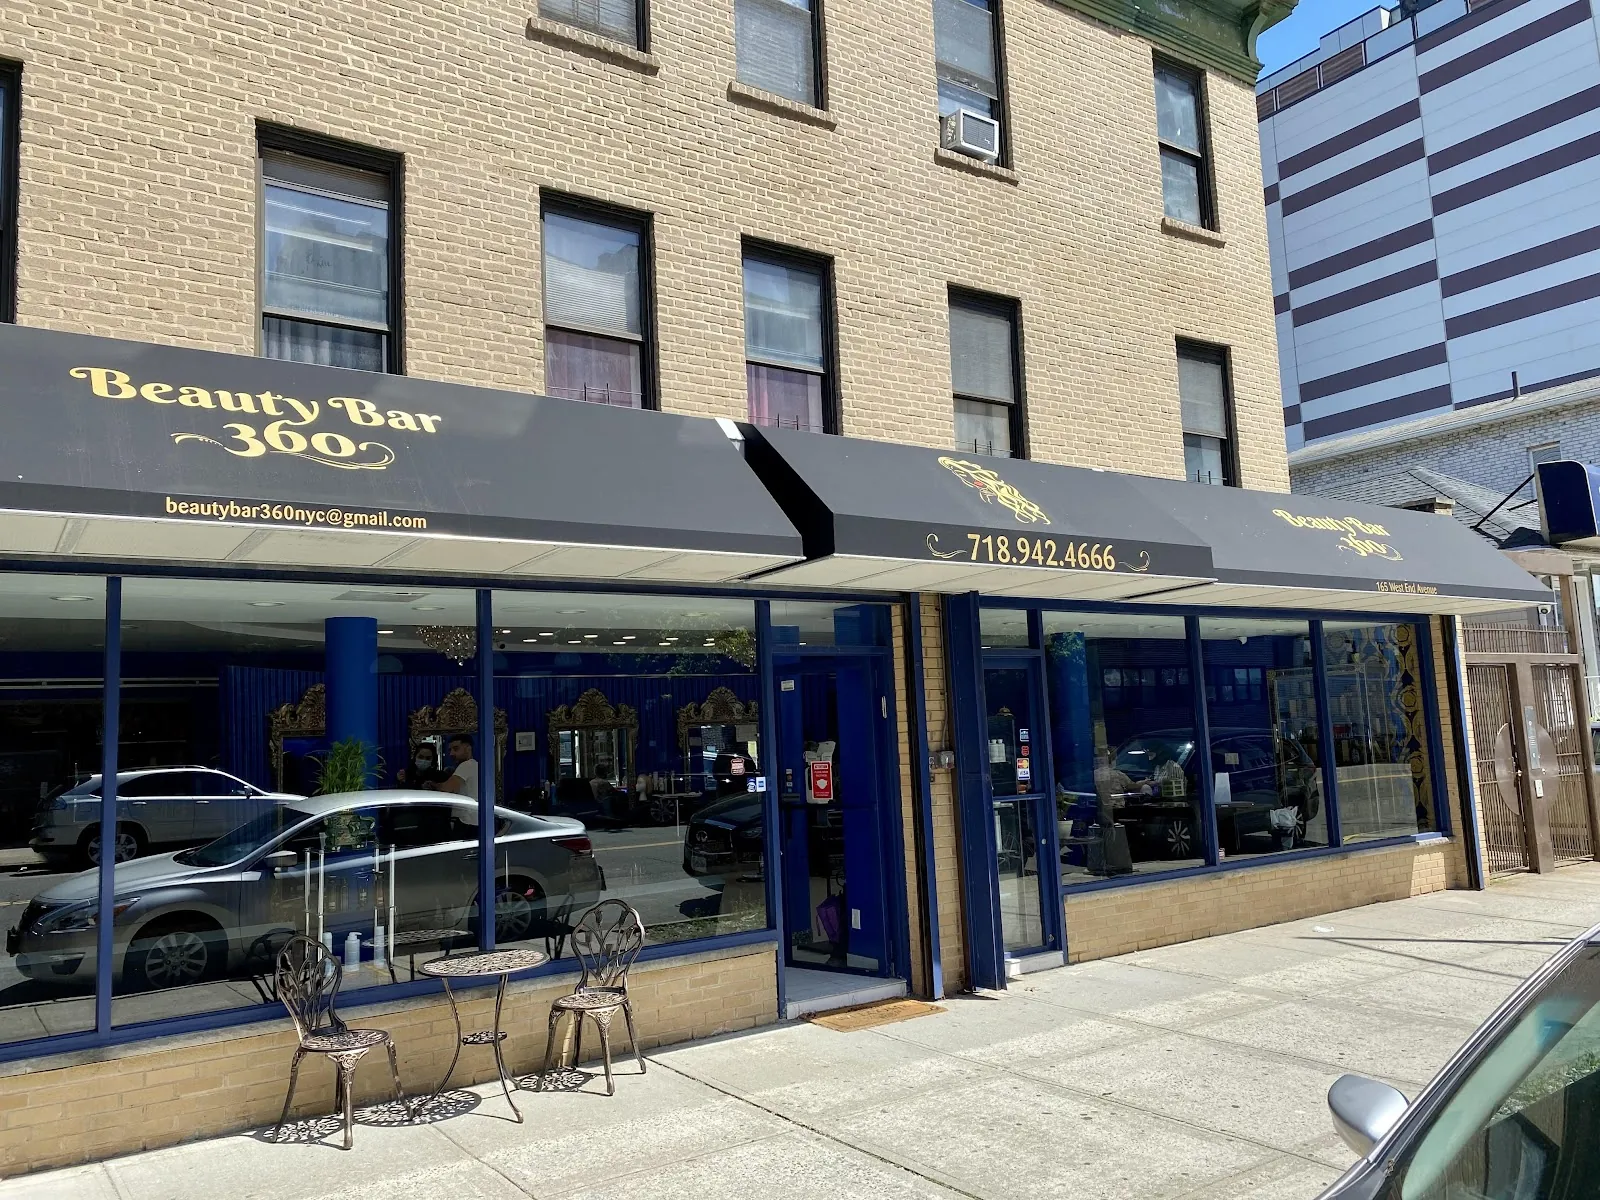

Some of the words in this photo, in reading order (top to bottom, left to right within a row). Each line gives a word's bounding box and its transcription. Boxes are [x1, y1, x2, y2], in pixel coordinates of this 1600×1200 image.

[69, 367, 320, 426] Beauty
[327, 396, 442, 434] Bar
[222, 420, 356, 458] 360
[165, 496, 427, 530] beautybar360nyc@gmail.com
[1272, 509, 1356, 537] Beauty
[1343, 516, 1391, 537] Bar
[967, 533, 1117, 571] 718.942.4666
[1340, 533, 1388, 557] 360
[1375, 581, 1390, 592] 165
[1388, 582, 1405, 593] West
[1404, 582, 1417, 594] End
[1416, 583, 1438, 595] Avenue
